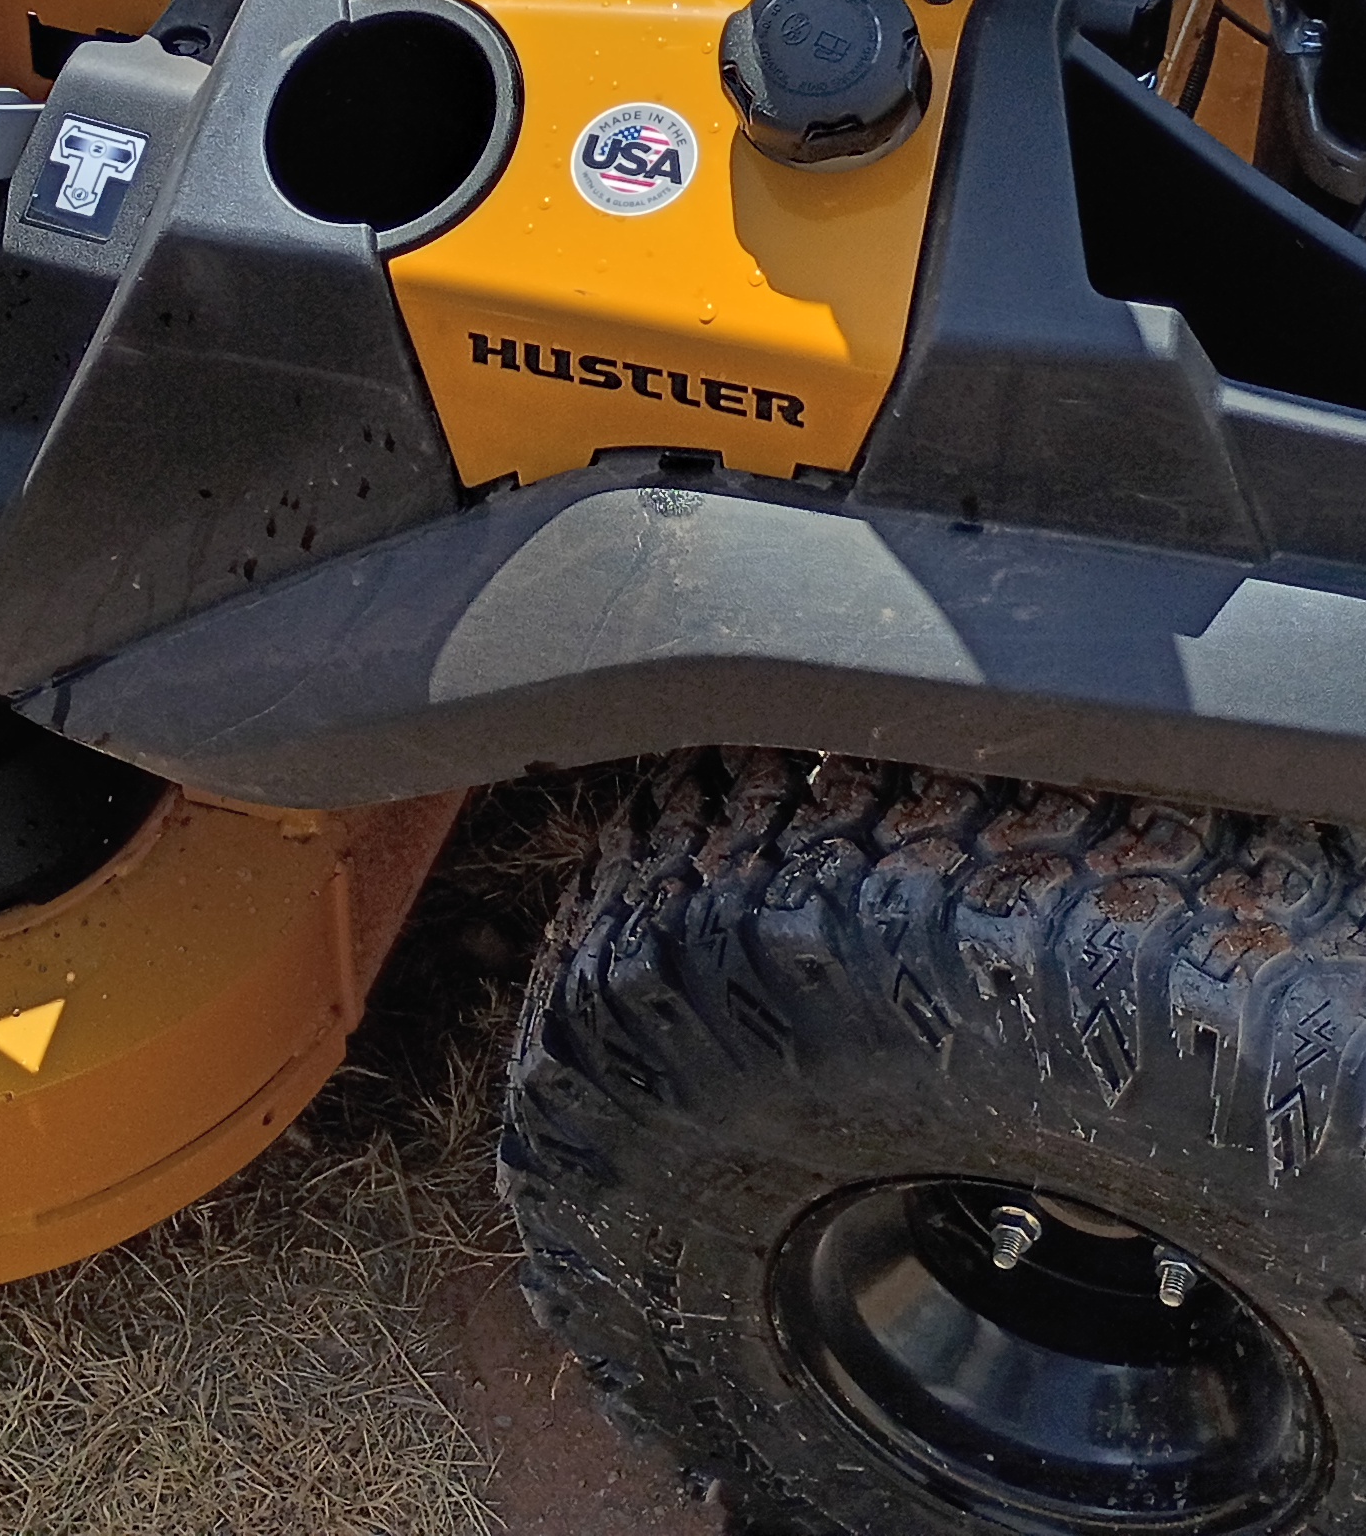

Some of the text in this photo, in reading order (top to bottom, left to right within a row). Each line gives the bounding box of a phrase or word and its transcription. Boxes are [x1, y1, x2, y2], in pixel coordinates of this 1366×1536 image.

[599, 110, 688, 148] MADE IN THE
[582, 133, 682, 185] USA
[612, 199, 645, 208] GLOBAL
[647, 186, 672, 204] PARTS
[468, 331, 805, 428] HUSTLER
